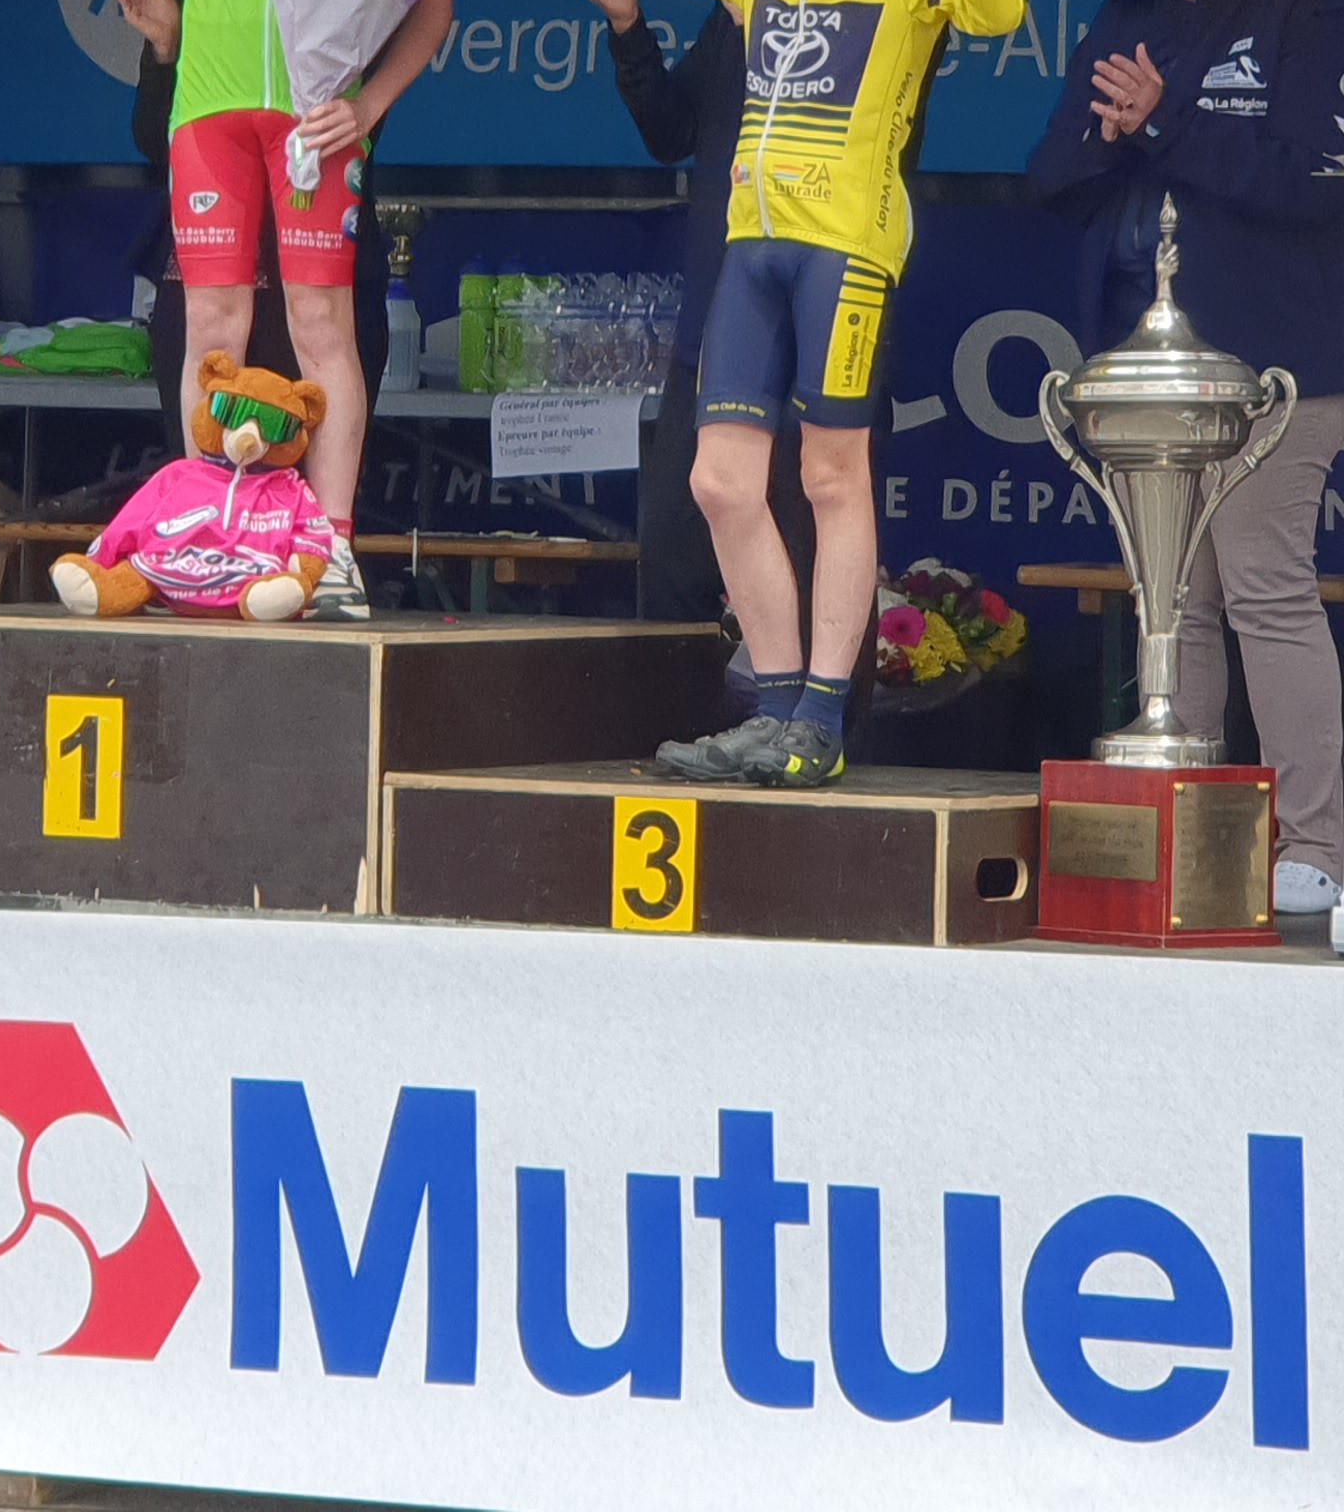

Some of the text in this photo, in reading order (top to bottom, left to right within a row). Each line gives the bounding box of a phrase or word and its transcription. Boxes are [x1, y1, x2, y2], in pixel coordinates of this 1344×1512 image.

[1214, 97, 1269, 113] La Région
[875, 183, 893, 235] Velay
[58, 714, 104, 824] 1
[626, 810, 684, 921] 3
[232, 1078, 1310, 1450] Mutuel
